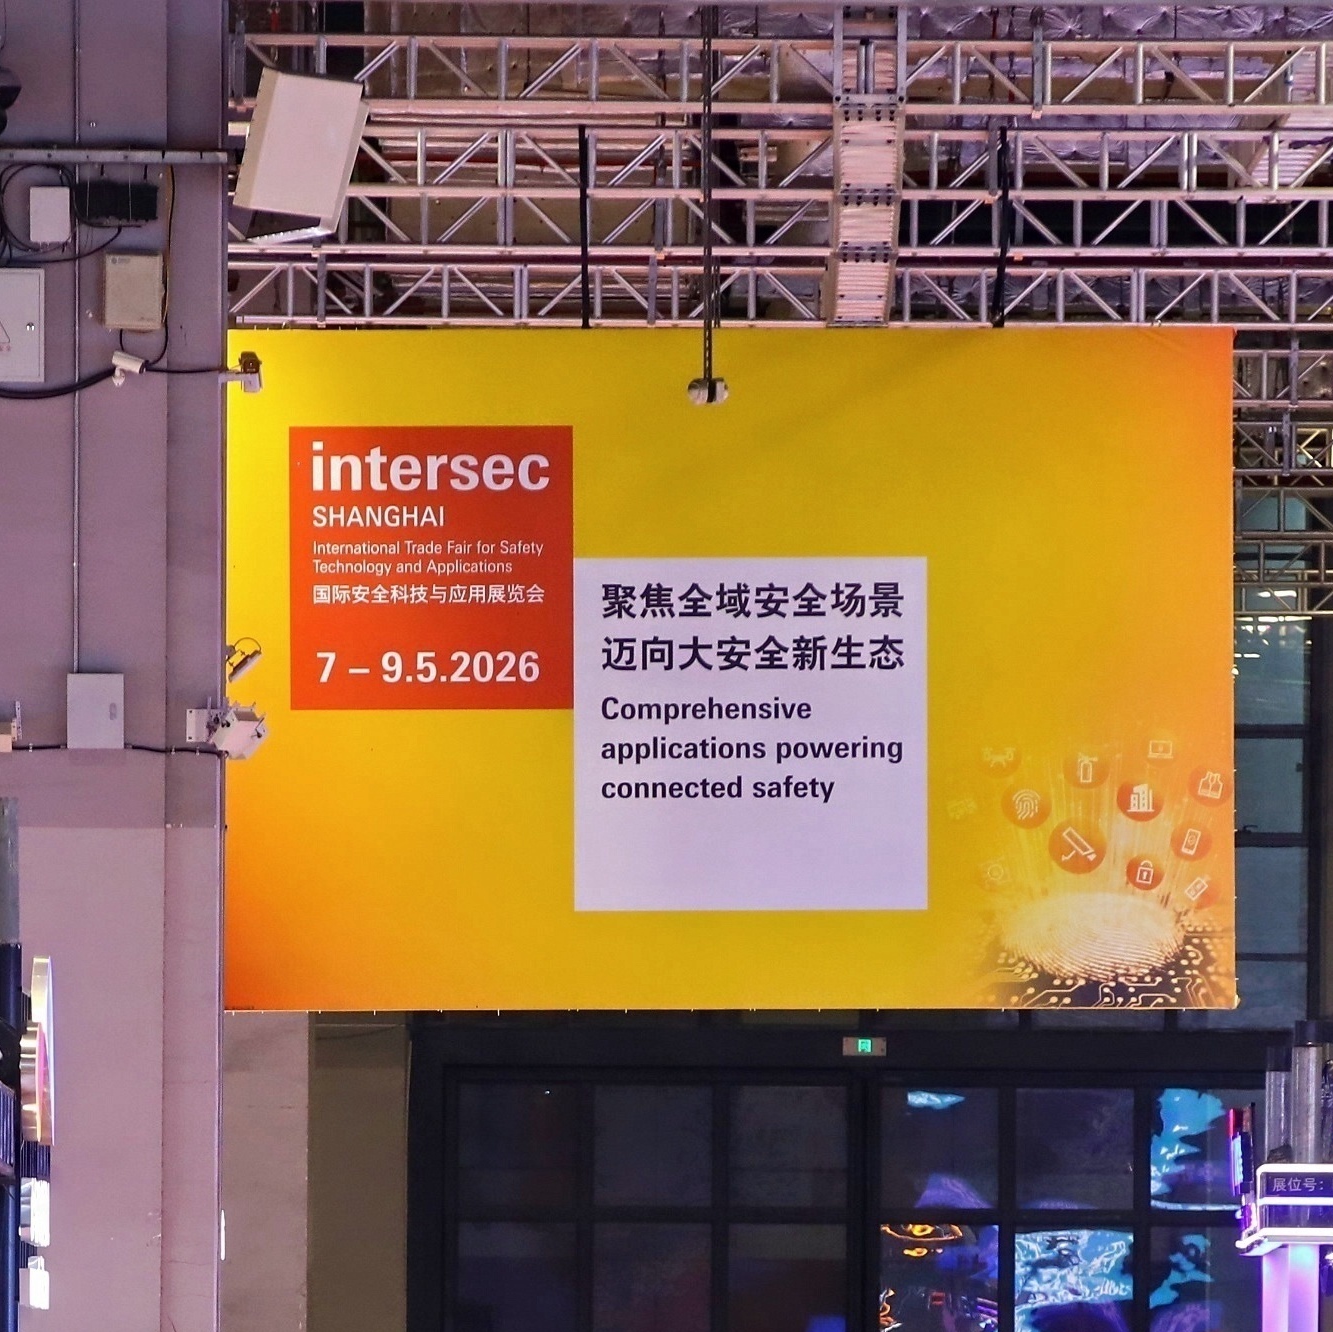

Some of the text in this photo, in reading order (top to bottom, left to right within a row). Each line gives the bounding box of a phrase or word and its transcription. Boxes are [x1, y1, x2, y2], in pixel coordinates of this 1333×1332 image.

[312, 441, 550, 492] intersec
[312, 505, 444, 528] SHANGHAI
[313, 540, 544, 557] International Trade Fair for Safety
[313, 559, 513, 577] Technology and Applications
[312, 583, 545, 605] 国际安全科技与应用展览会
[601, 582, 904, 619] 聚焦全域安全场景
[316, 651, 336, 683] 7
[381, 650, 540, 683] 9.5.2026
[601, 634, 905, 672] 迈向大安全新生态
[601, 696, 812, 724] Comprehensive
[601, 735, 903, 765] applications powering
[601, 775, 835, 804] connected safety
